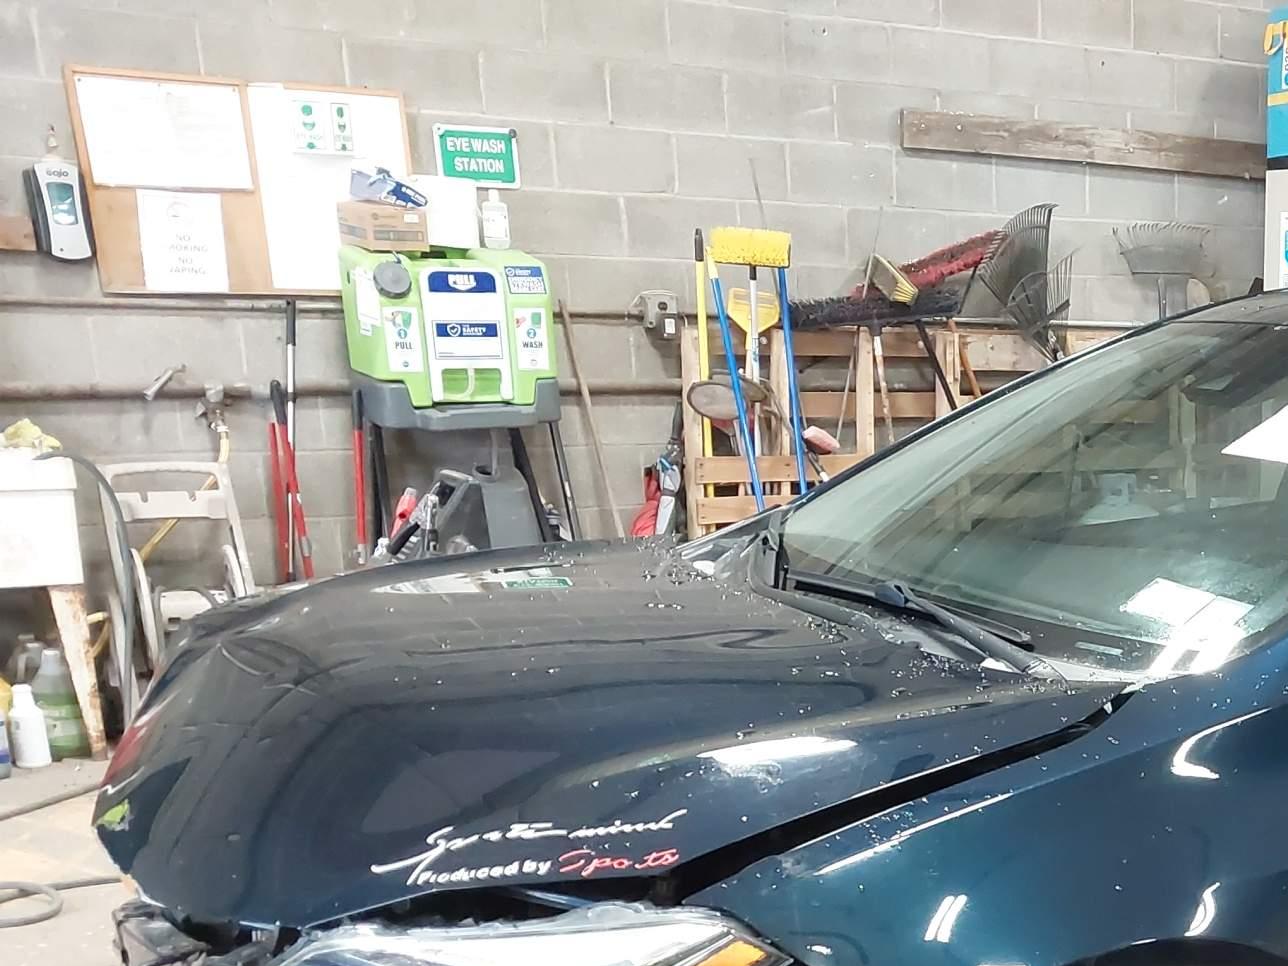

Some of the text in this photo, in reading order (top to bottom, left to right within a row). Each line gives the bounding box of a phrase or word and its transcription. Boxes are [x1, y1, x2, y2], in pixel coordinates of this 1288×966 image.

[445, 136, 506, 155] EYE WASH
[454, 156, 505, 174] STATION
[395, 341, 413, 350] PULL
[417, 859, 520, 885] Produced
[521, 858, 552, 875] by
